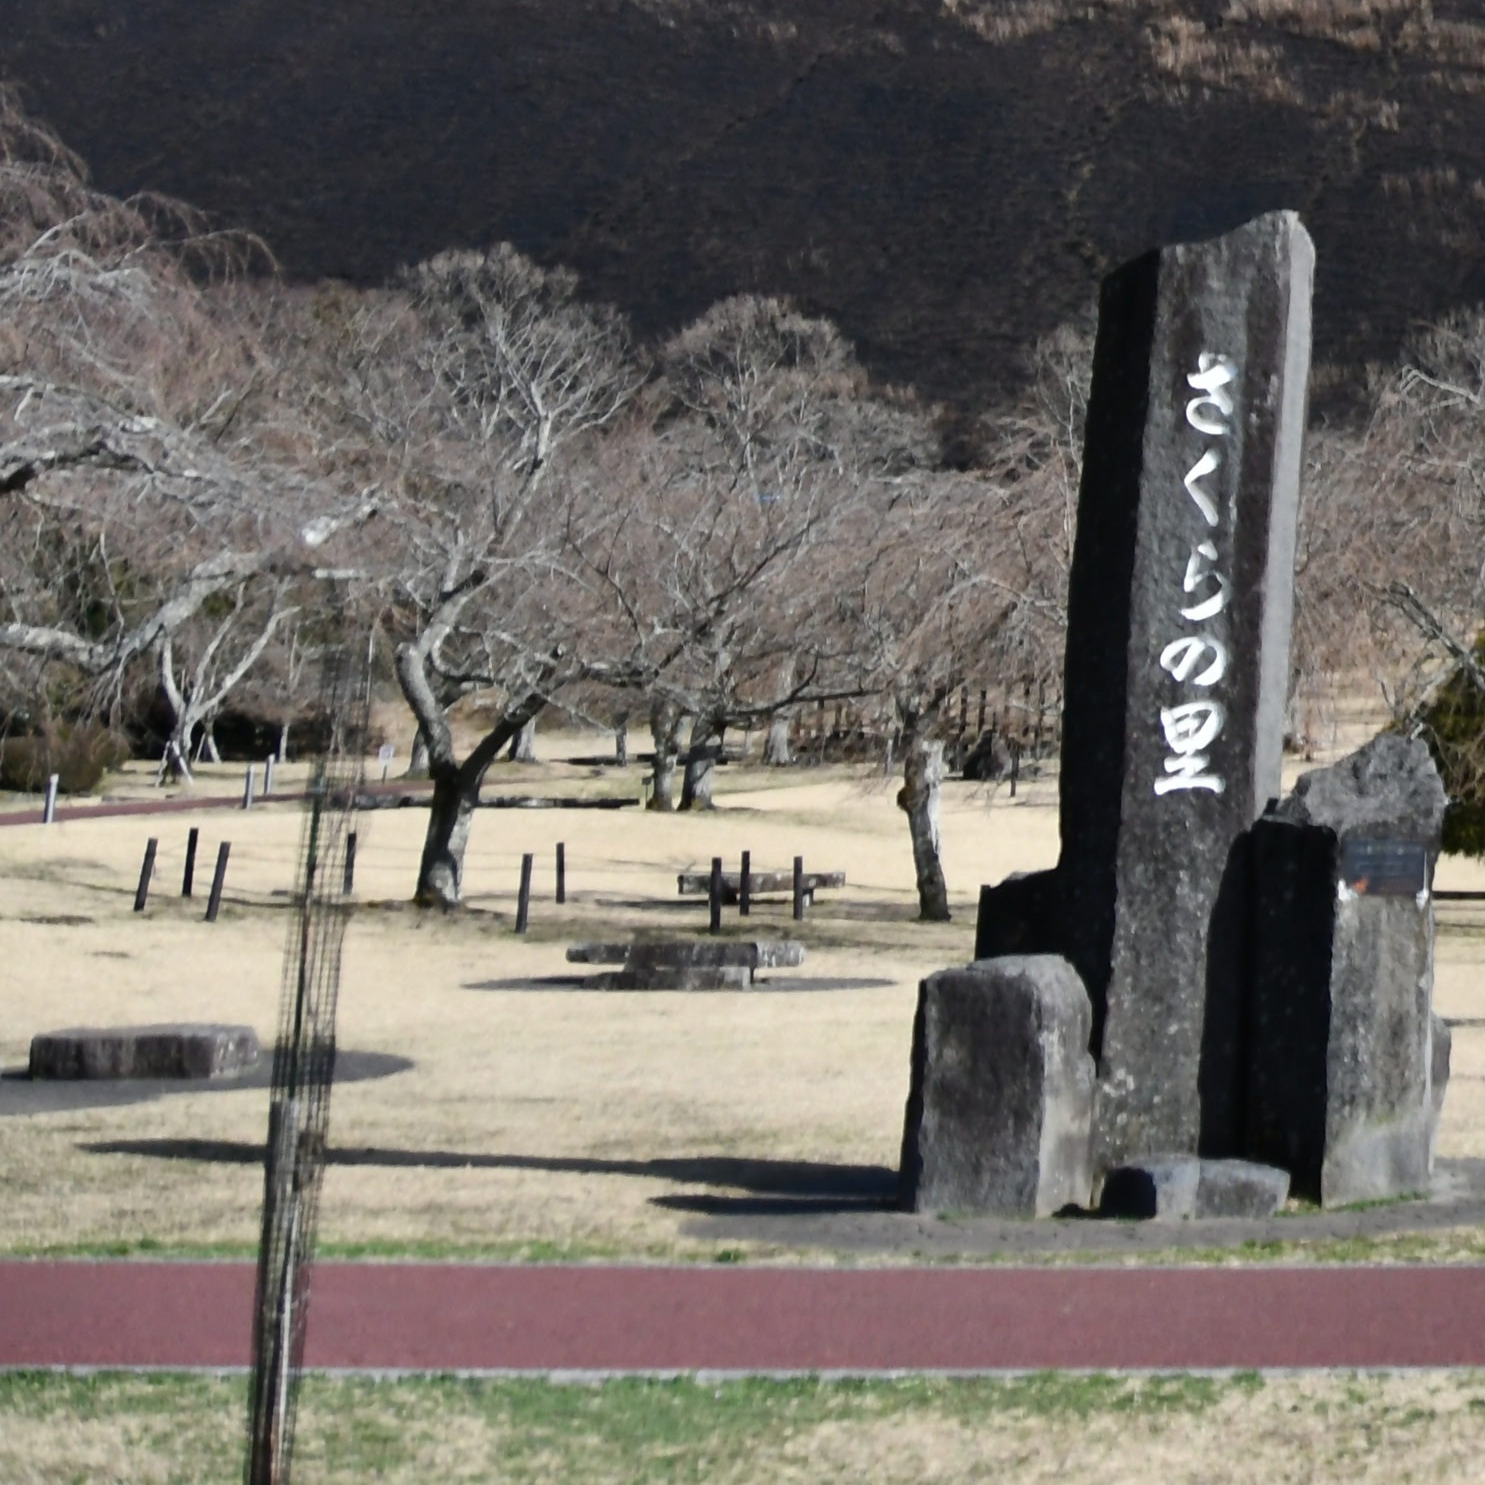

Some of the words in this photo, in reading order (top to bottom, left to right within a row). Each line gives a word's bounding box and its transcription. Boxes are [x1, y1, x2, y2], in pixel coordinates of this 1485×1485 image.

[1153, 352, 1238, 795] さくらの里
